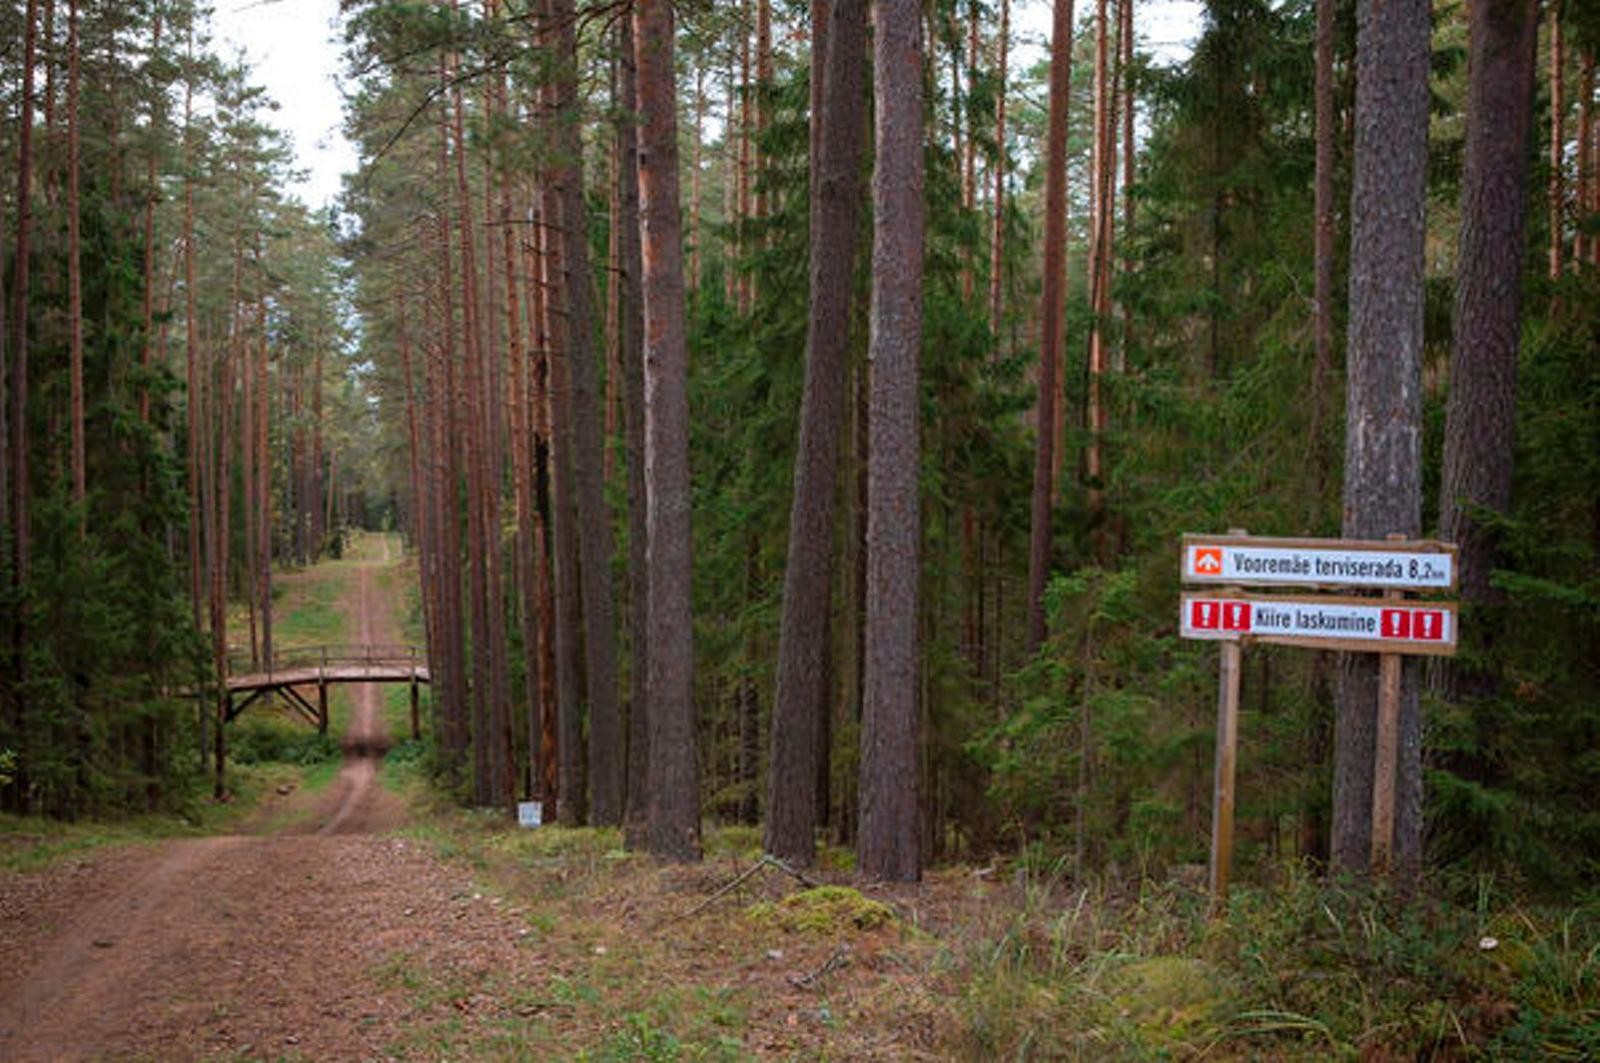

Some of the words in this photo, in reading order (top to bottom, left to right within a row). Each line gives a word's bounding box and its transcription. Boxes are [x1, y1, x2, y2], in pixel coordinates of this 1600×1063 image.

[1234, 553, 1310, 574] Vooremäe
[1316, 557, 1402, 579] terviserada
[1409, 559, 1444, 581] 8,2
[1255, 606, 1290, 628] Kiire
[1296, 609, 1376, 632] laskumine
